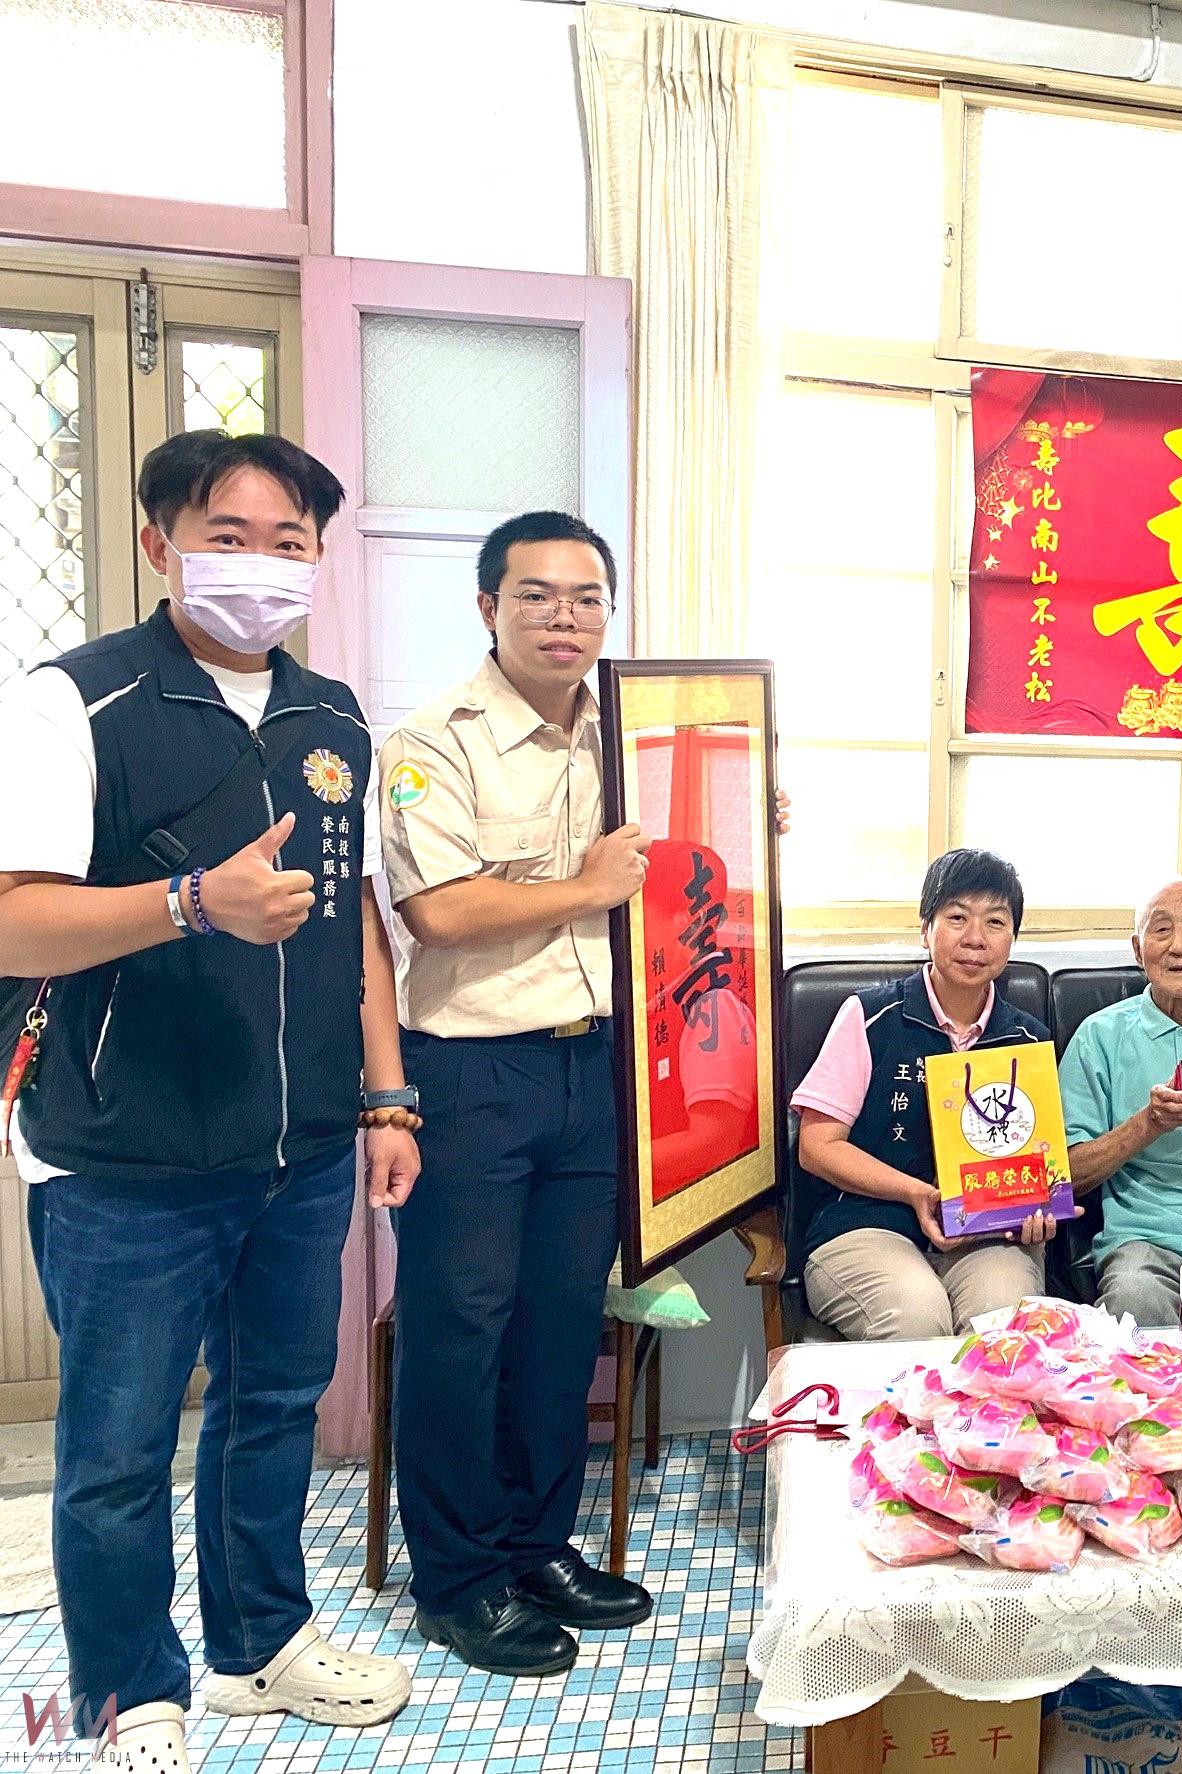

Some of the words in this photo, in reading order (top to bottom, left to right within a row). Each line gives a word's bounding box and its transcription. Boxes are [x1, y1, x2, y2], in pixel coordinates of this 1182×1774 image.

[1024, 439, 1062, 703] 壽比南山不老松
[321, 815, 338, 919] 榮民服務處
[338, 815, 351, 879] 南投縣
[890, 1063, 912, 1142] 王怡文
